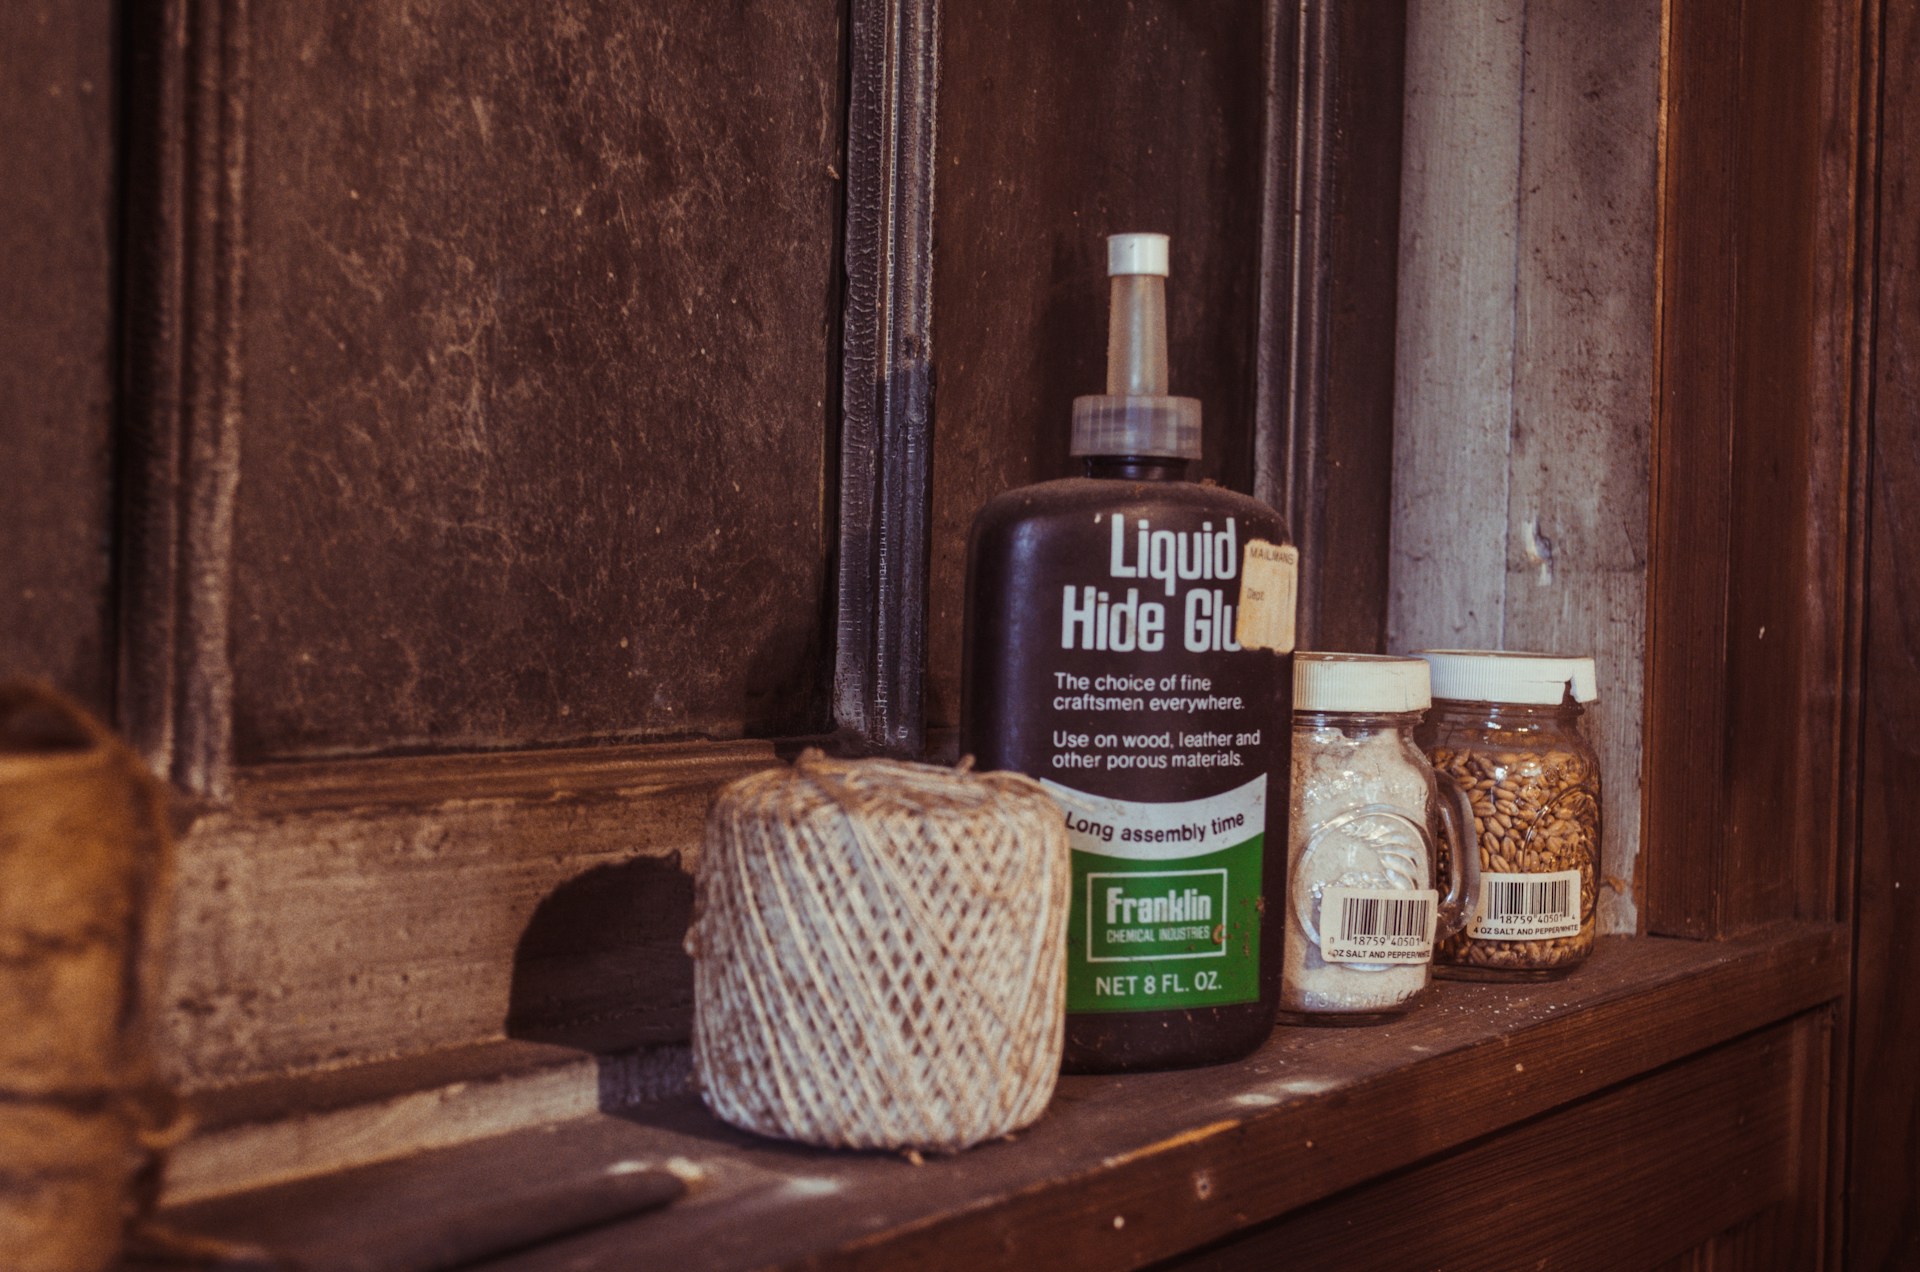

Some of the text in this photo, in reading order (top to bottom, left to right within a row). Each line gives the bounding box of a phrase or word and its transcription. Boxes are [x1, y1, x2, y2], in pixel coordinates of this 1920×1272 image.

[1110, 513, 1236, 596] Liquid
[1061, 585, 1242, 652] Hide Glu
[1054, 672, 1211, 691] The choice of fine
[1053, 693, 1245, 713] craftsmen everywhere.
[1053, 729, 1261, 749] Use on wood, leather and
[1052, 750, 1244, 770] other porous materials.
[1065, 811, 1245, 843] Long assembly time
[1106, 887, 1212, 924] Franklin
[1499, 915, 1533, 924] 18759
[1537, 913, 1563, 923] 40501
[1106, 925, 1211, 944] CHEMICAL INDUSTRIES
[1480, 926, 1492, 935] OZ
[1494, 927, 1515, 935] SALT
[1516, 926, 1534, 935] AND
[1353, 936, 1386, 946] 18759
[1390, 937, 1420, 947] 40501
[1346, 949, 1367, 958] SALT
[1368, 950, 1386, 959] AND
[1095, 971, 1222, 996] NET 8 FL. OZ.
